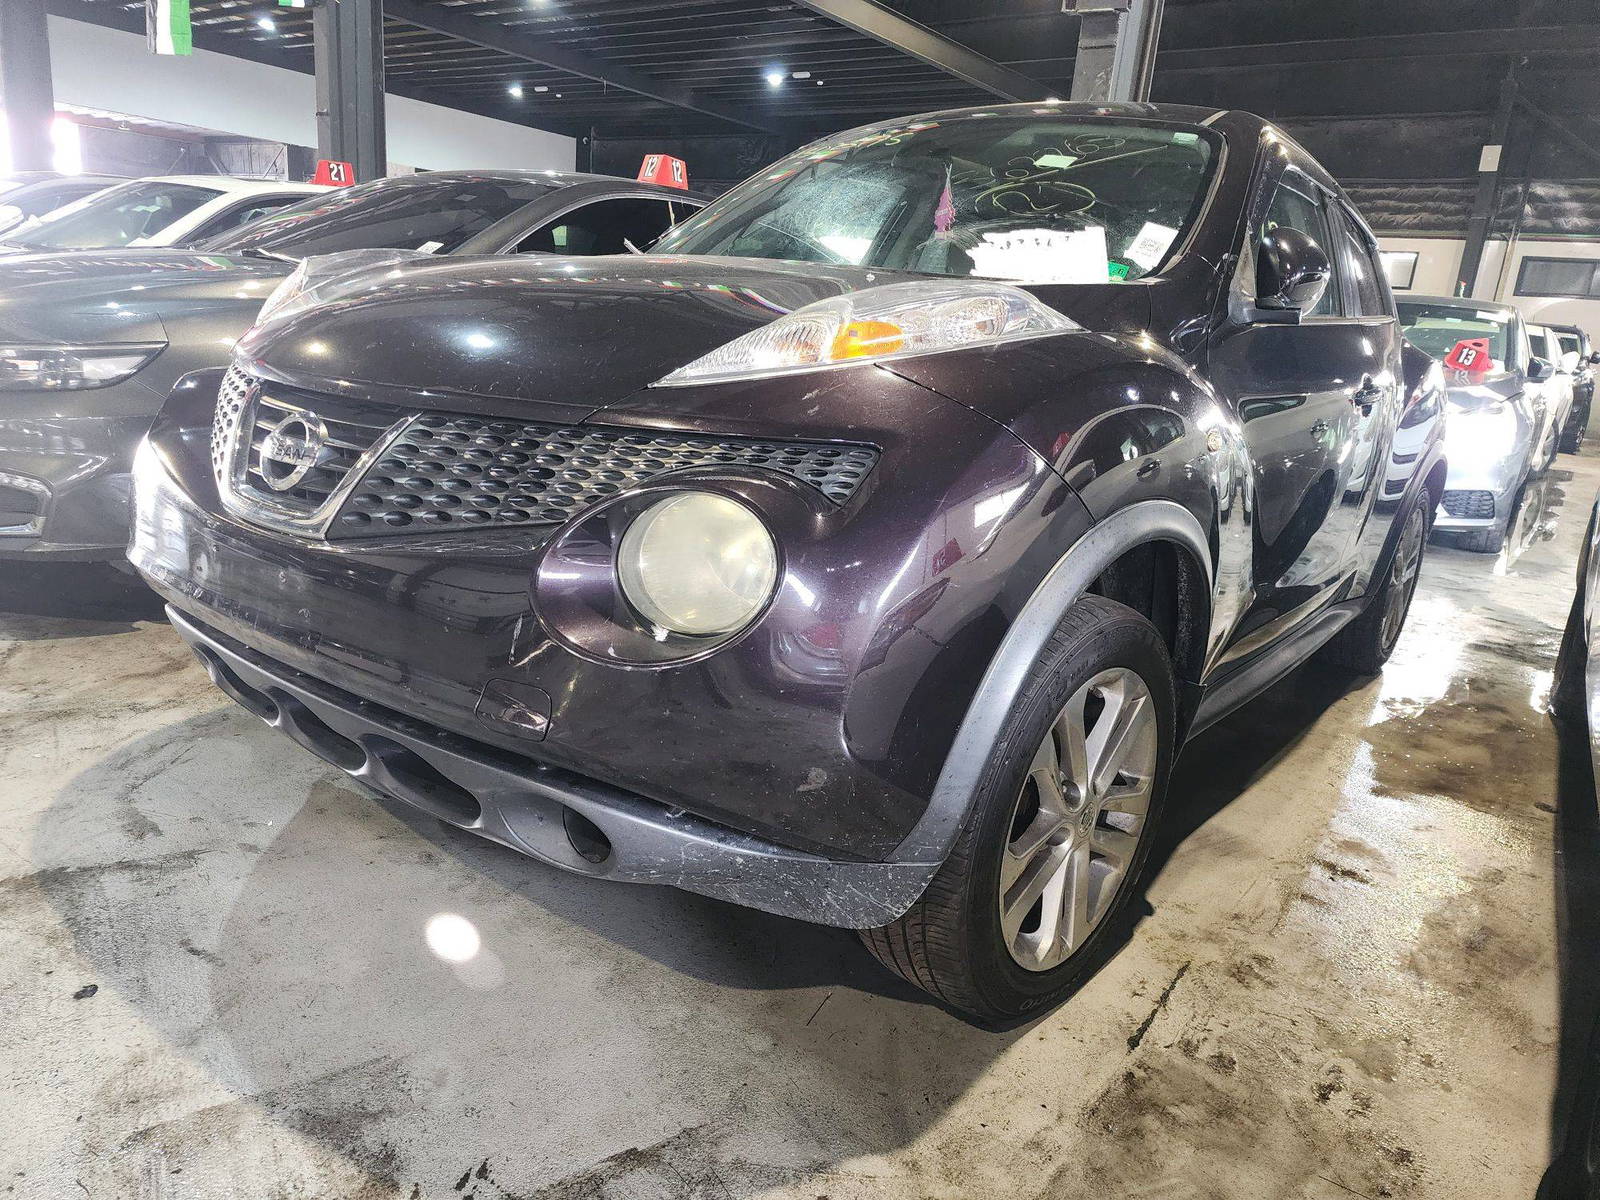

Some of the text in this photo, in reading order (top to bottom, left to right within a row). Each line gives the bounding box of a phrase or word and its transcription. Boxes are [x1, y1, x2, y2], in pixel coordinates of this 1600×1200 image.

[329, 163, 345, 182] 21
[644, 156, 658, 177] 12
[672, 159, 683, 183] 12
[1457, 347, 1477, 366] 13
